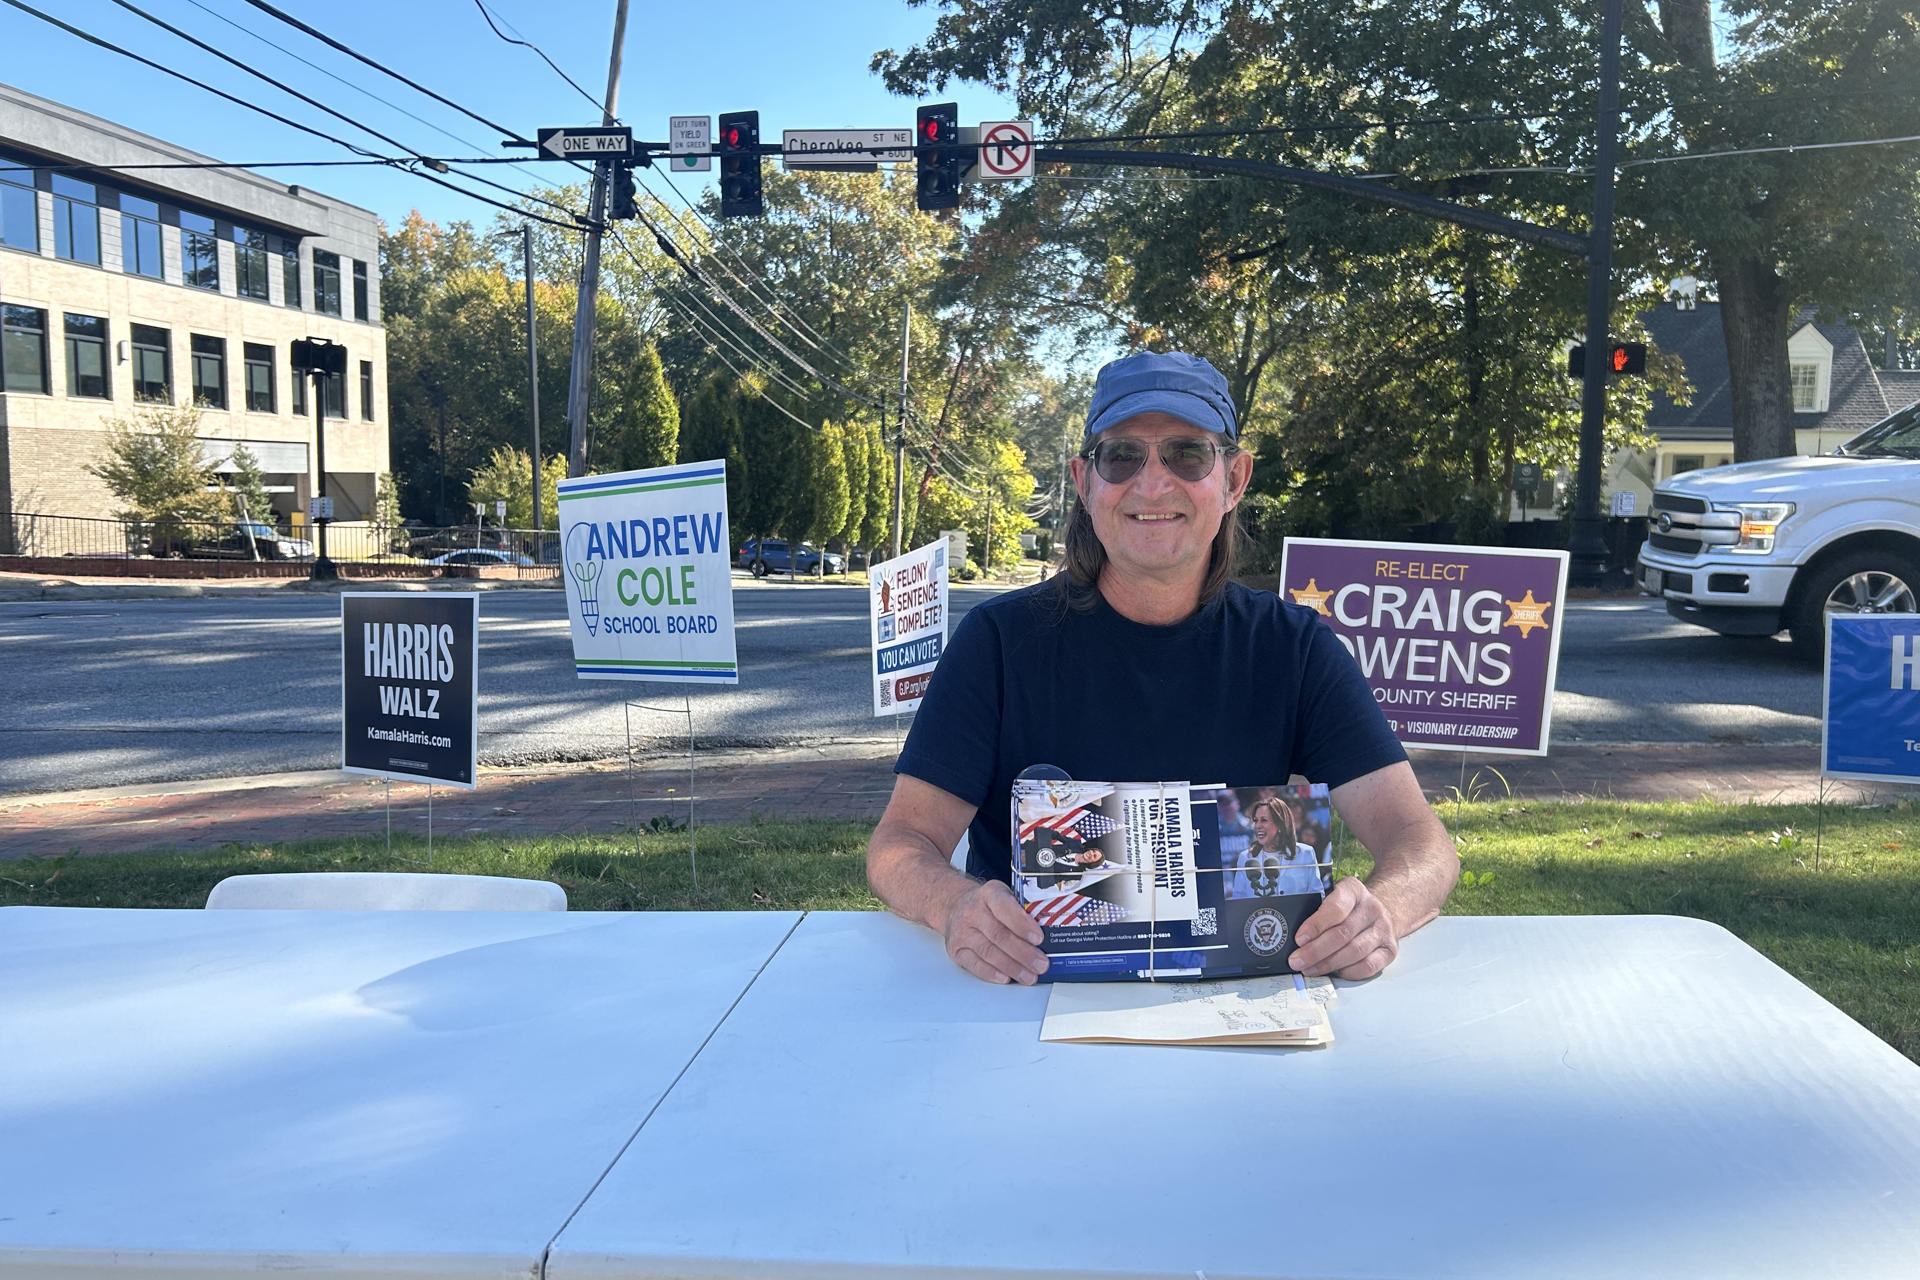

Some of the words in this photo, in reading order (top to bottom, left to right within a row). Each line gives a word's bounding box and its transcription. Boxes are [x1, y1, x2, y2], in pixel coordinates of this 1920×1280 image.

[563, 138, 590, 151] ONE
[596, 137, 624, 150] WAY
[680, 130, 701, 138] YIELD
[790, 138, 863, 154] Cherokee
[873, 134, 884, 142] ST
[894, 134, 906, 142] NE
[586, 512, 722, 560] ANDREW
[897, 560, 928, 590] FELONY
[1376, 560, 1468, 581] RE-ELECT
[617, 565, 697, 607] COLE
[898, 581, 938, 612] SENTENCE
[898, 604, 942, 634] COMPLETE?
[1334, 583, 1502, 635] CRAIG
[1514, 609, 1540, 620] SHERIFF
[604, 617, 660, 634] SCHOOL
[668, 616, 718, 634] BOARD
[364, 623, 454, 682] HARRIS
[881, 650, 898, 670] YOU
[899, 644, 915, 666] CAN
[917, 639, 939, 660] VOTE.
[1335, 633, 1512, 687] WENS
[379, 686, 440, 719] WALZ
[1370, 687, 1435, 706] OUNTY
[1440, 692, 1517, 710] SHERIFF
[367, 726, 451, 748] KamalaHarris.com
[1407, 721, 1457, 736] VISIONARY
[1458, 725, 1518, 739] LEADERSHIP
[1165, 798, 1182, 848] KAMALA
[1169, 852, 1186, 898] HARRIS
